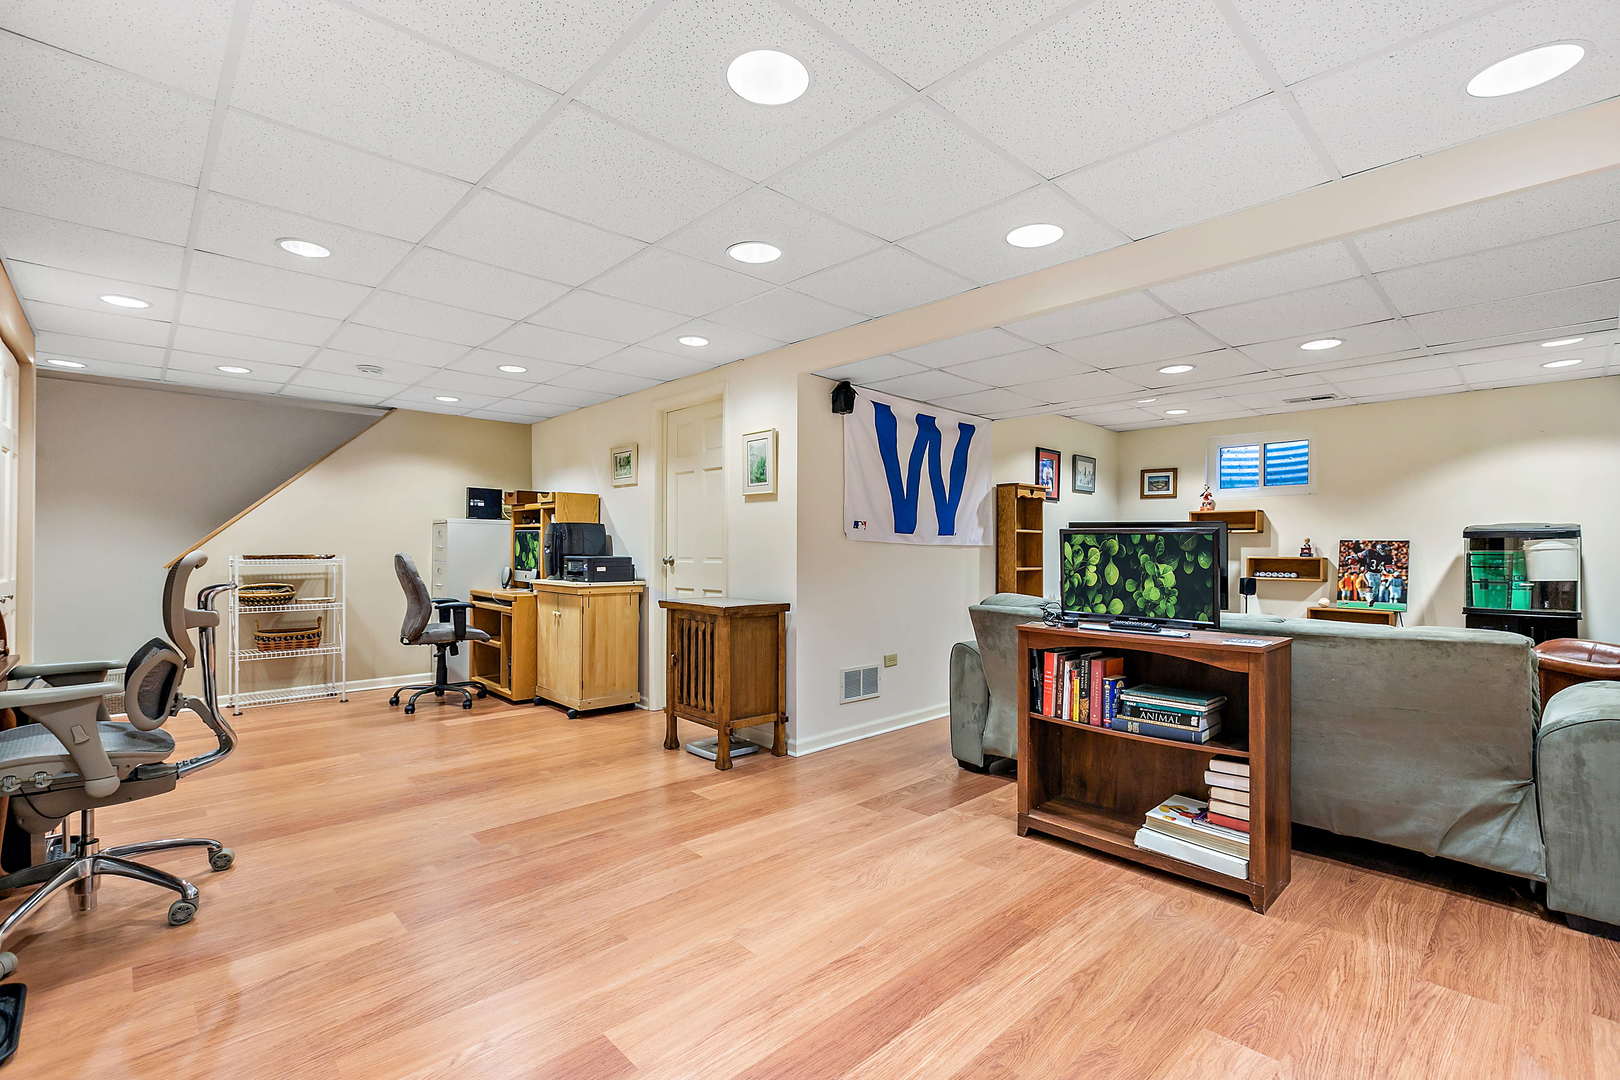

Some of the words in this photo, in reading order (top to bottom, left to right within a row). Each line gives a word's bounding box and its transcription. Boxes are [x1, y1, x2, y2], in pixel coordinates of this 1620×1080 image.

[870, 400, 976, 536] W
[1370, 559, 1384, 570] 34
[1140, 711, 1181, 725] ANIMAL
